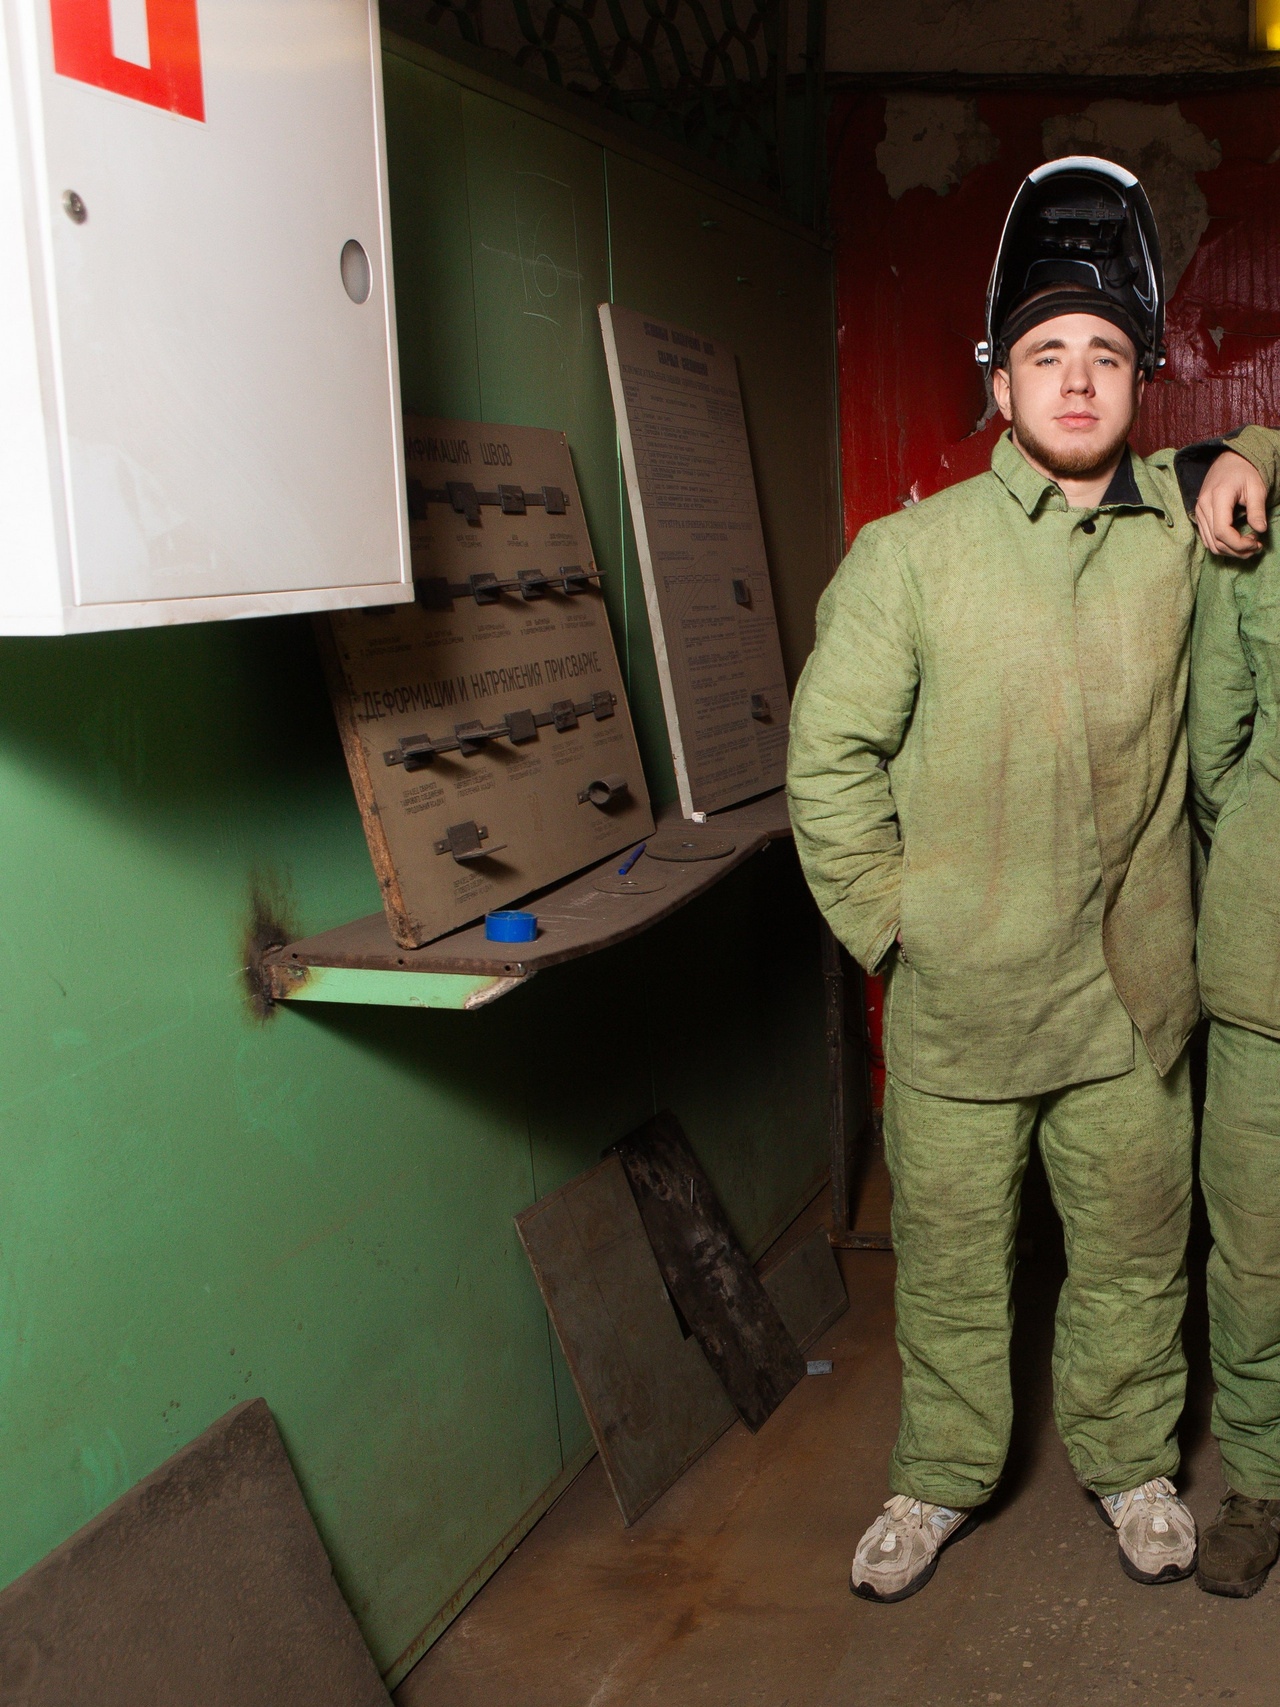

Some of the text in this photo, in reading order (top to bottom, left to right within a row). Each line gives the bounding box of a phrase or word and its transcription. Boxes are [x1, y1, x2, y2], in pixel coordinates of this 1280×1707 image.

[479, 442, 513, 467] ШВОВ
[363, 651, 602, 724] ДЕФОРМАЦИИ И НАПРЯЖЕНИЯ ПРИ СВАРКЕ
